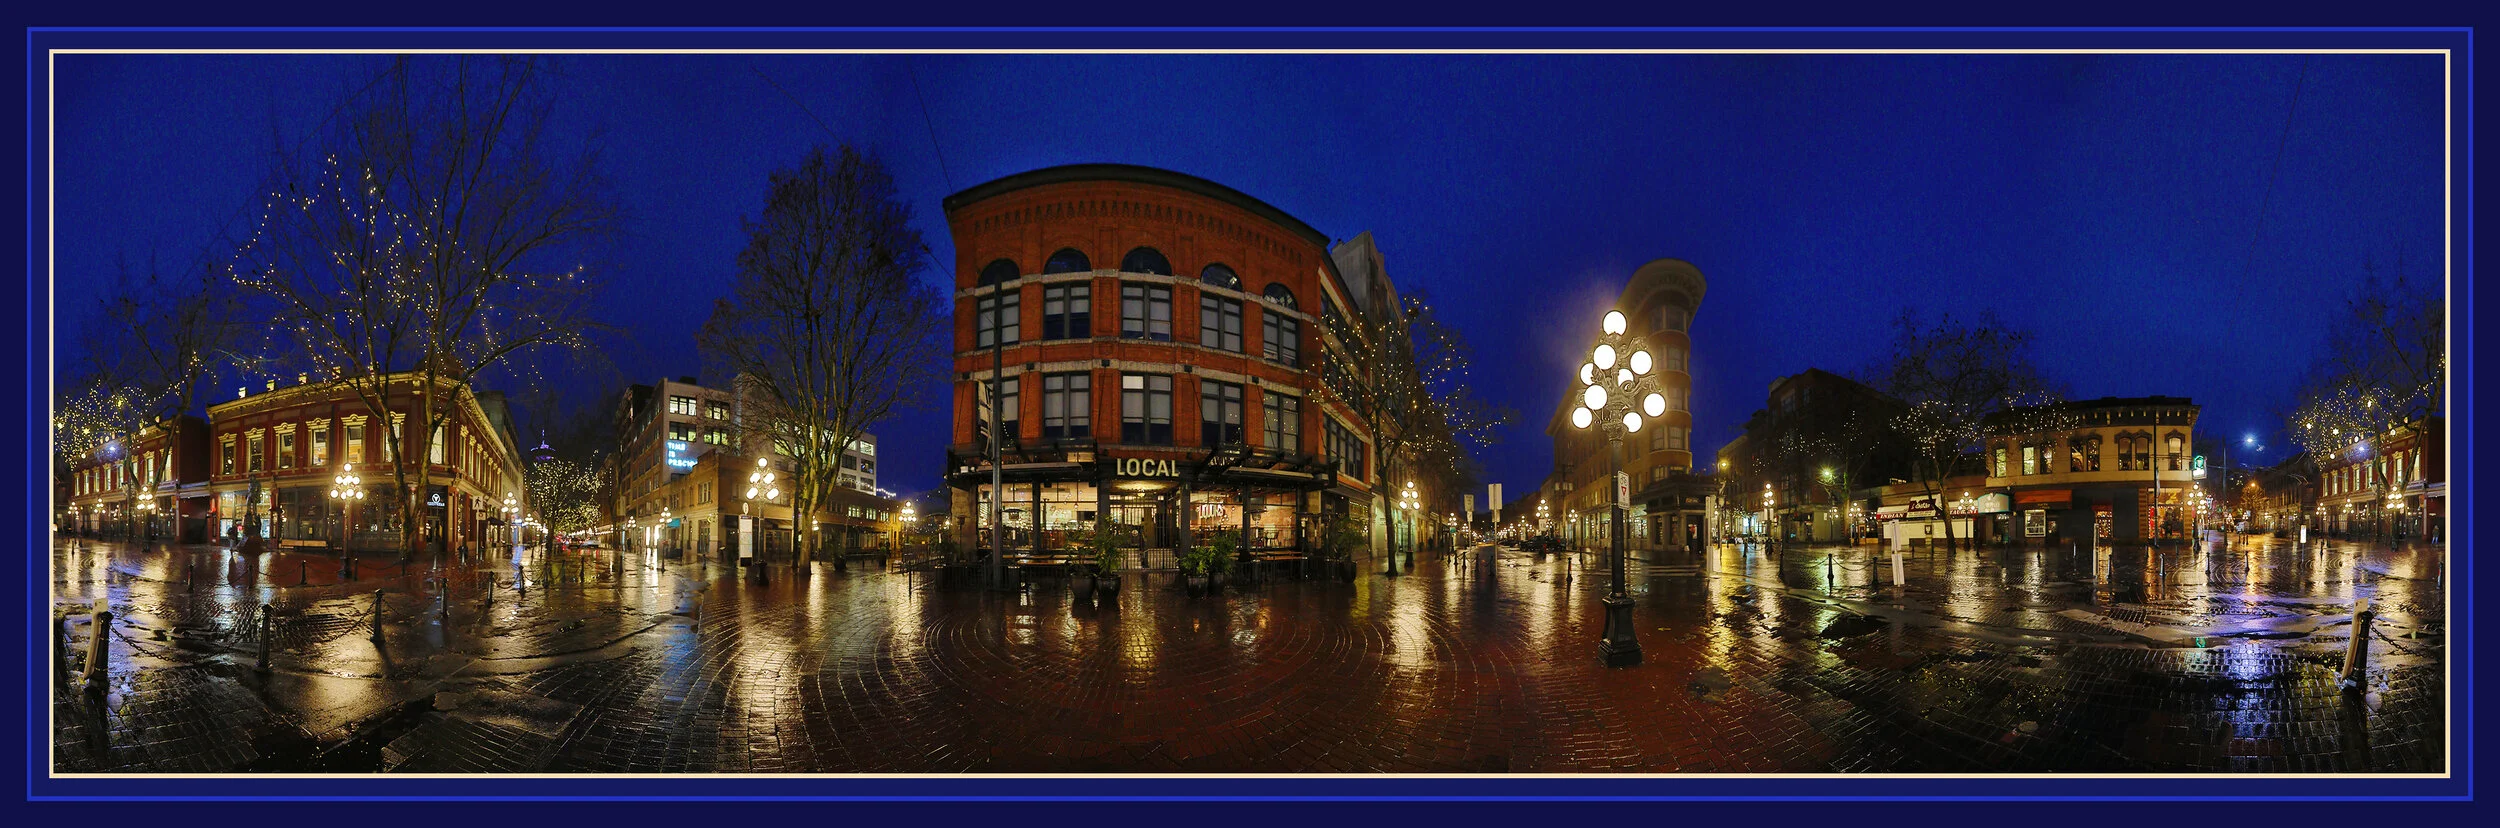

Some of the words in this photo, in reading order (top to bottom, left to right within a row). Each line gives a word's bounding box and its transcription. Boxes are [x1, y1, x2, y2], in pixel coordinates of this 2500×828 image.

[667, 441, 686, 451] TIME
[668, 450, 676, 458] IS
[1116, 457, 1181, 477] LOCAL
